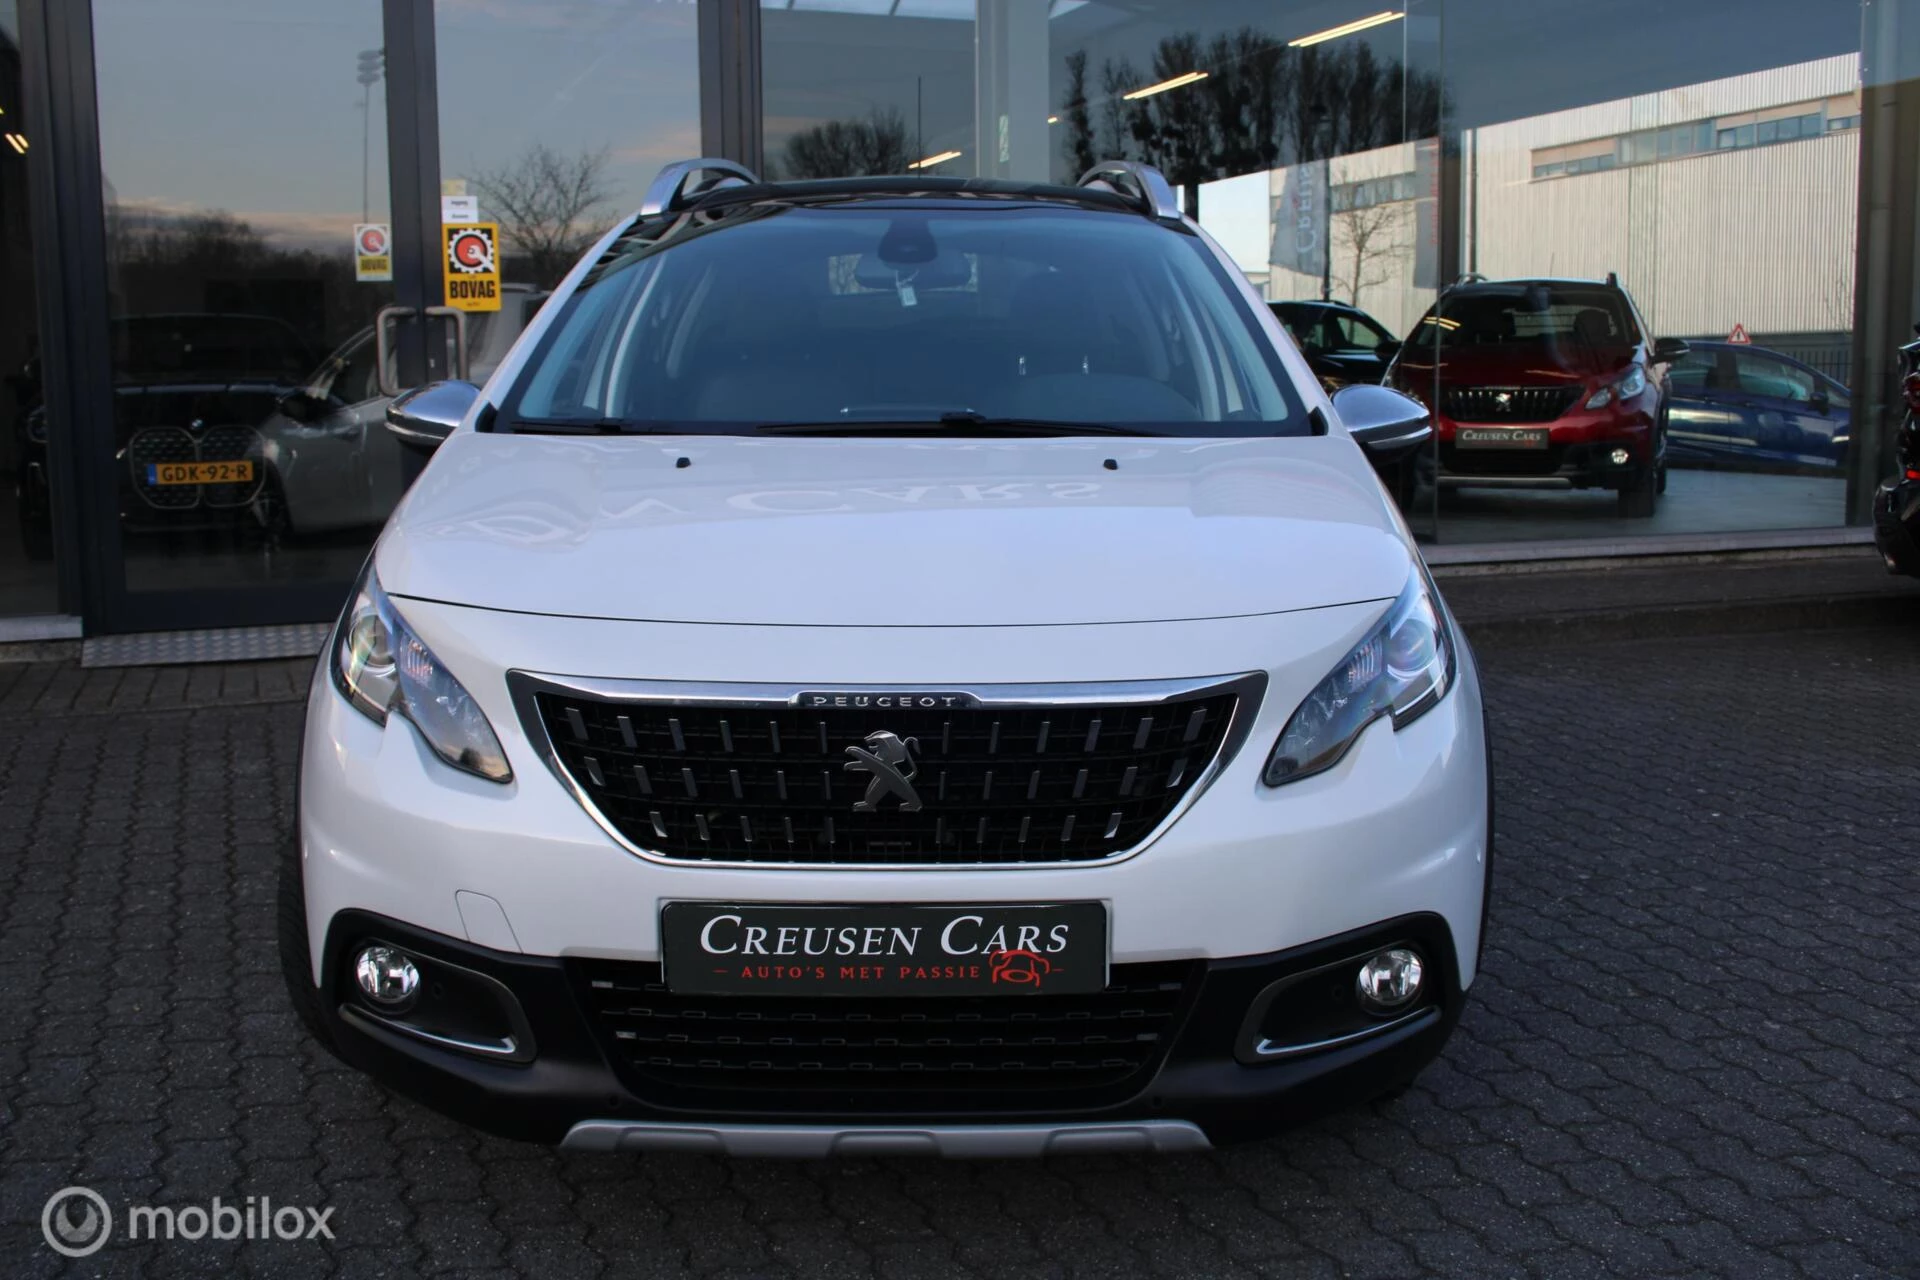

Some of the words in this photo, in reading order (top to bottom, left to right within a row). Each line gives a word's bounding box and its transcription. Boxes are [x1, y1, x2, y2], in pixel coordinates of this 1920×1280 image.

[450, 280, 496, 299] BOVAG
[162, 464, 248, 482] GDK-92-R
[813, 696, 956, 707] PEUGEOT
[700, 914, 922, 956] CREUSEN
[940, 915, 1069, 955] CARS
[741, 965, 826, 980] AUTO'S
[840, 966, 884, 980] MET
[900, 965, 980, 980] PASSIE
